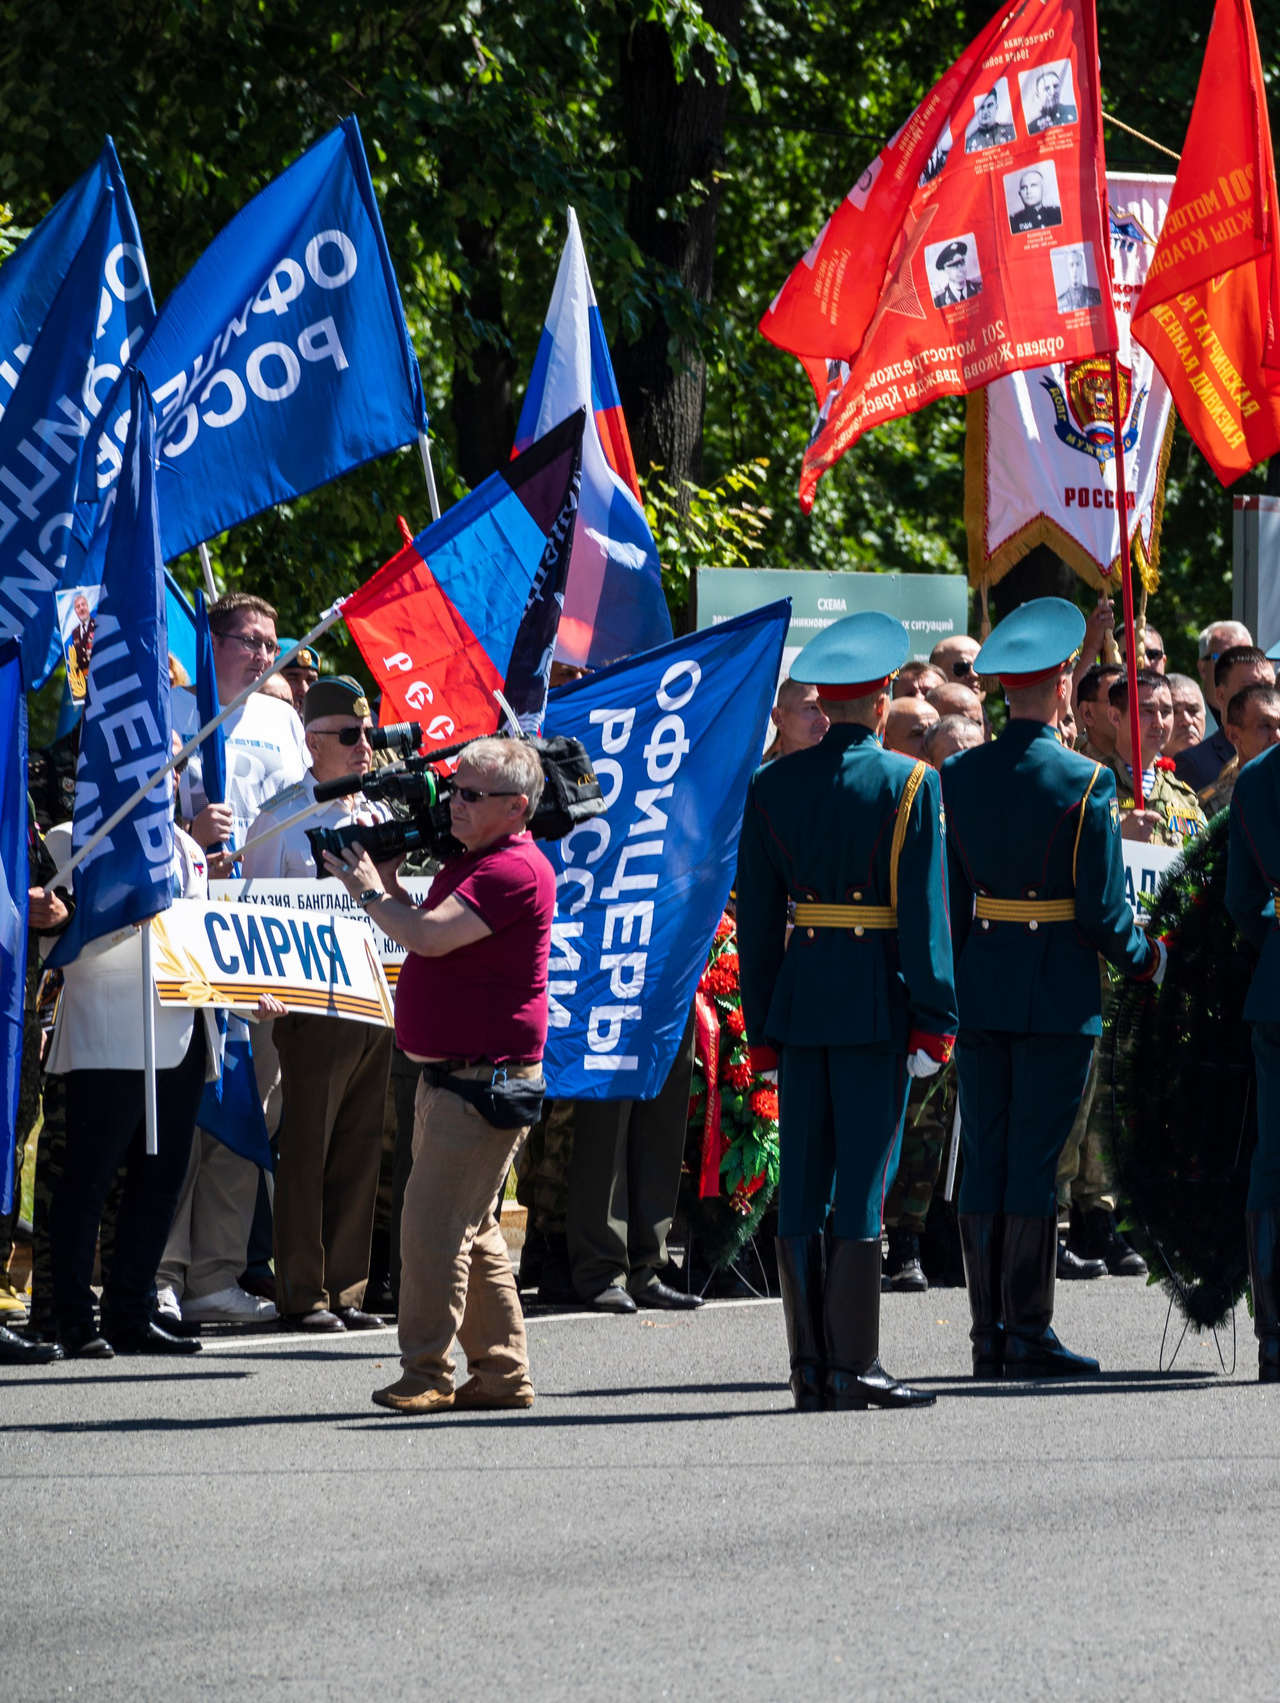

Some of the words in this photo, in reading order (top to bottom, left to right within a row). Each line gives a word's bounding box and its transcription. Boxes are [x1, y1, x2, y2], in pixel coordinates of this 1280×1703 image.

[1188, 308, 1261, 419] ГАТЧИНСКАЯ
[1049, 386, 1068, 422] ДОЛГ
[1188, 371, 1246, 451] ДИВИЗИЯ
[817, 597, 847, 612] СХЕМА
[910, 617, 954, 634] ситуаций
[583, 659, 702, 1071] ОФИЦЕРЫ
[204, 911, 352, 986] СИРИЯ
